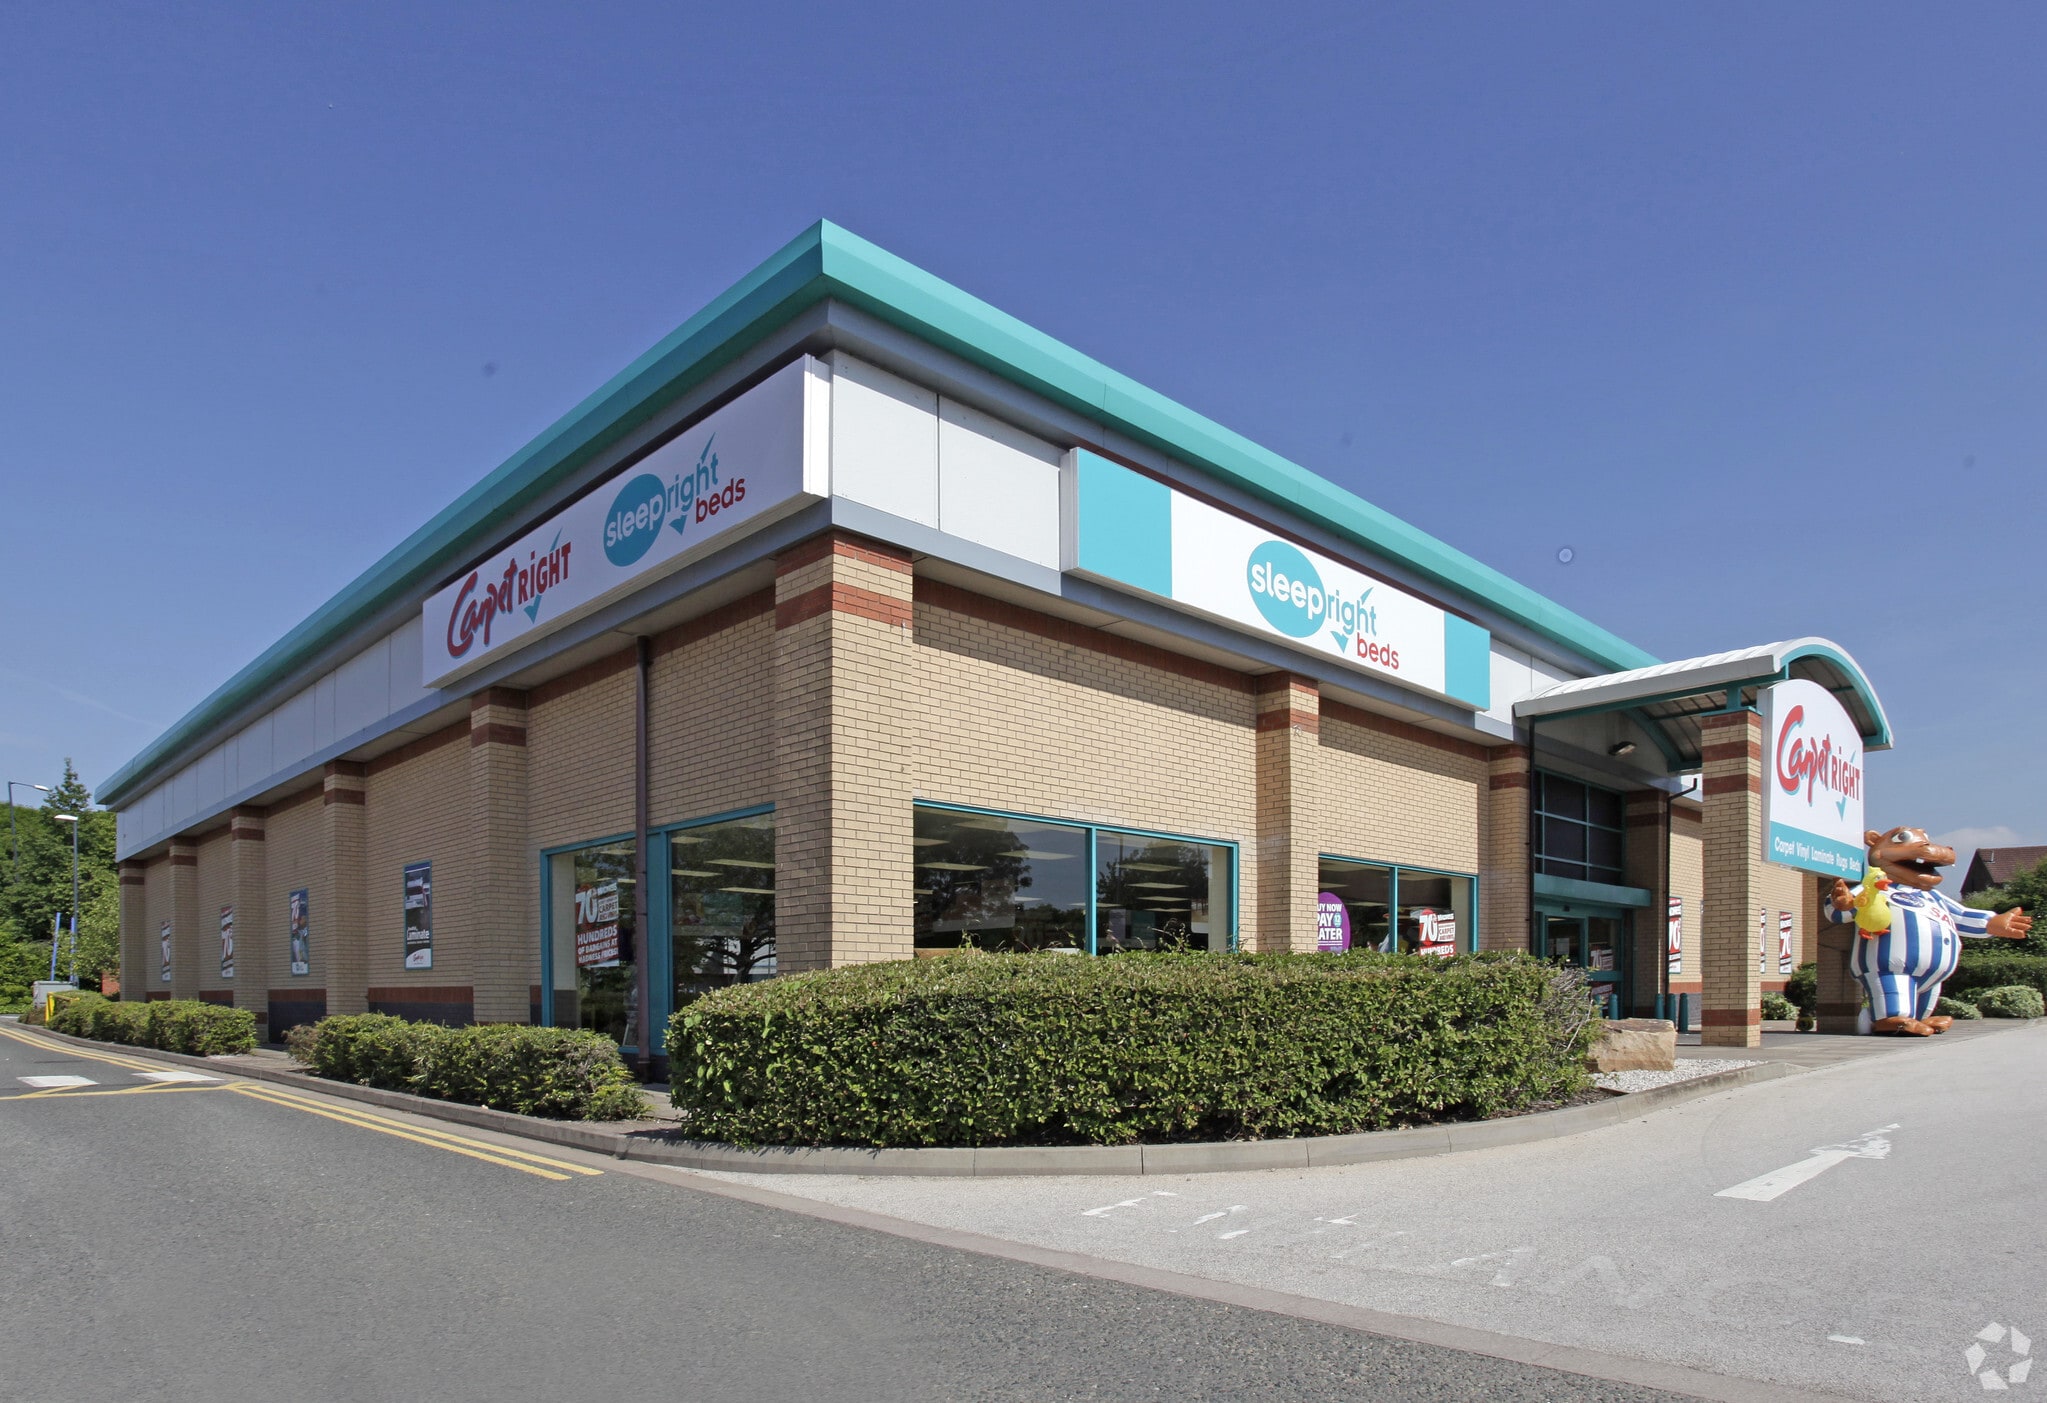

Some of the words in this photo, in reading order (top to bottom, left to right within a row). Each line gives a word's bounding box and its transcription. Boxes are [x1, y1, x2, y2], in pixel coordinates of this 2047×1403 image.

[695, 477, 746, 524] beds
[1356, 632, 1400, 671] beds
[1774, 836, 1795, 857] Carpet
[1796, 842, 1810, 862] Vinyl
[1811, 846, 1835, 865] Laminate
[1836, 853, 1849, 872] Rugs
[1849, 857, 1862, 872] Beds
[1316, 903, 1326, 912] UY
[1326, 903, 1342, 912] NOW
[577, 924, 618, 945] HUNDREDS
[1317, 927, 1343, 940] ATER
[1438, 927, 1454, 935] CARPET
[577, 946, 585, 955] OF
[611, 937, 618, 947] AT
